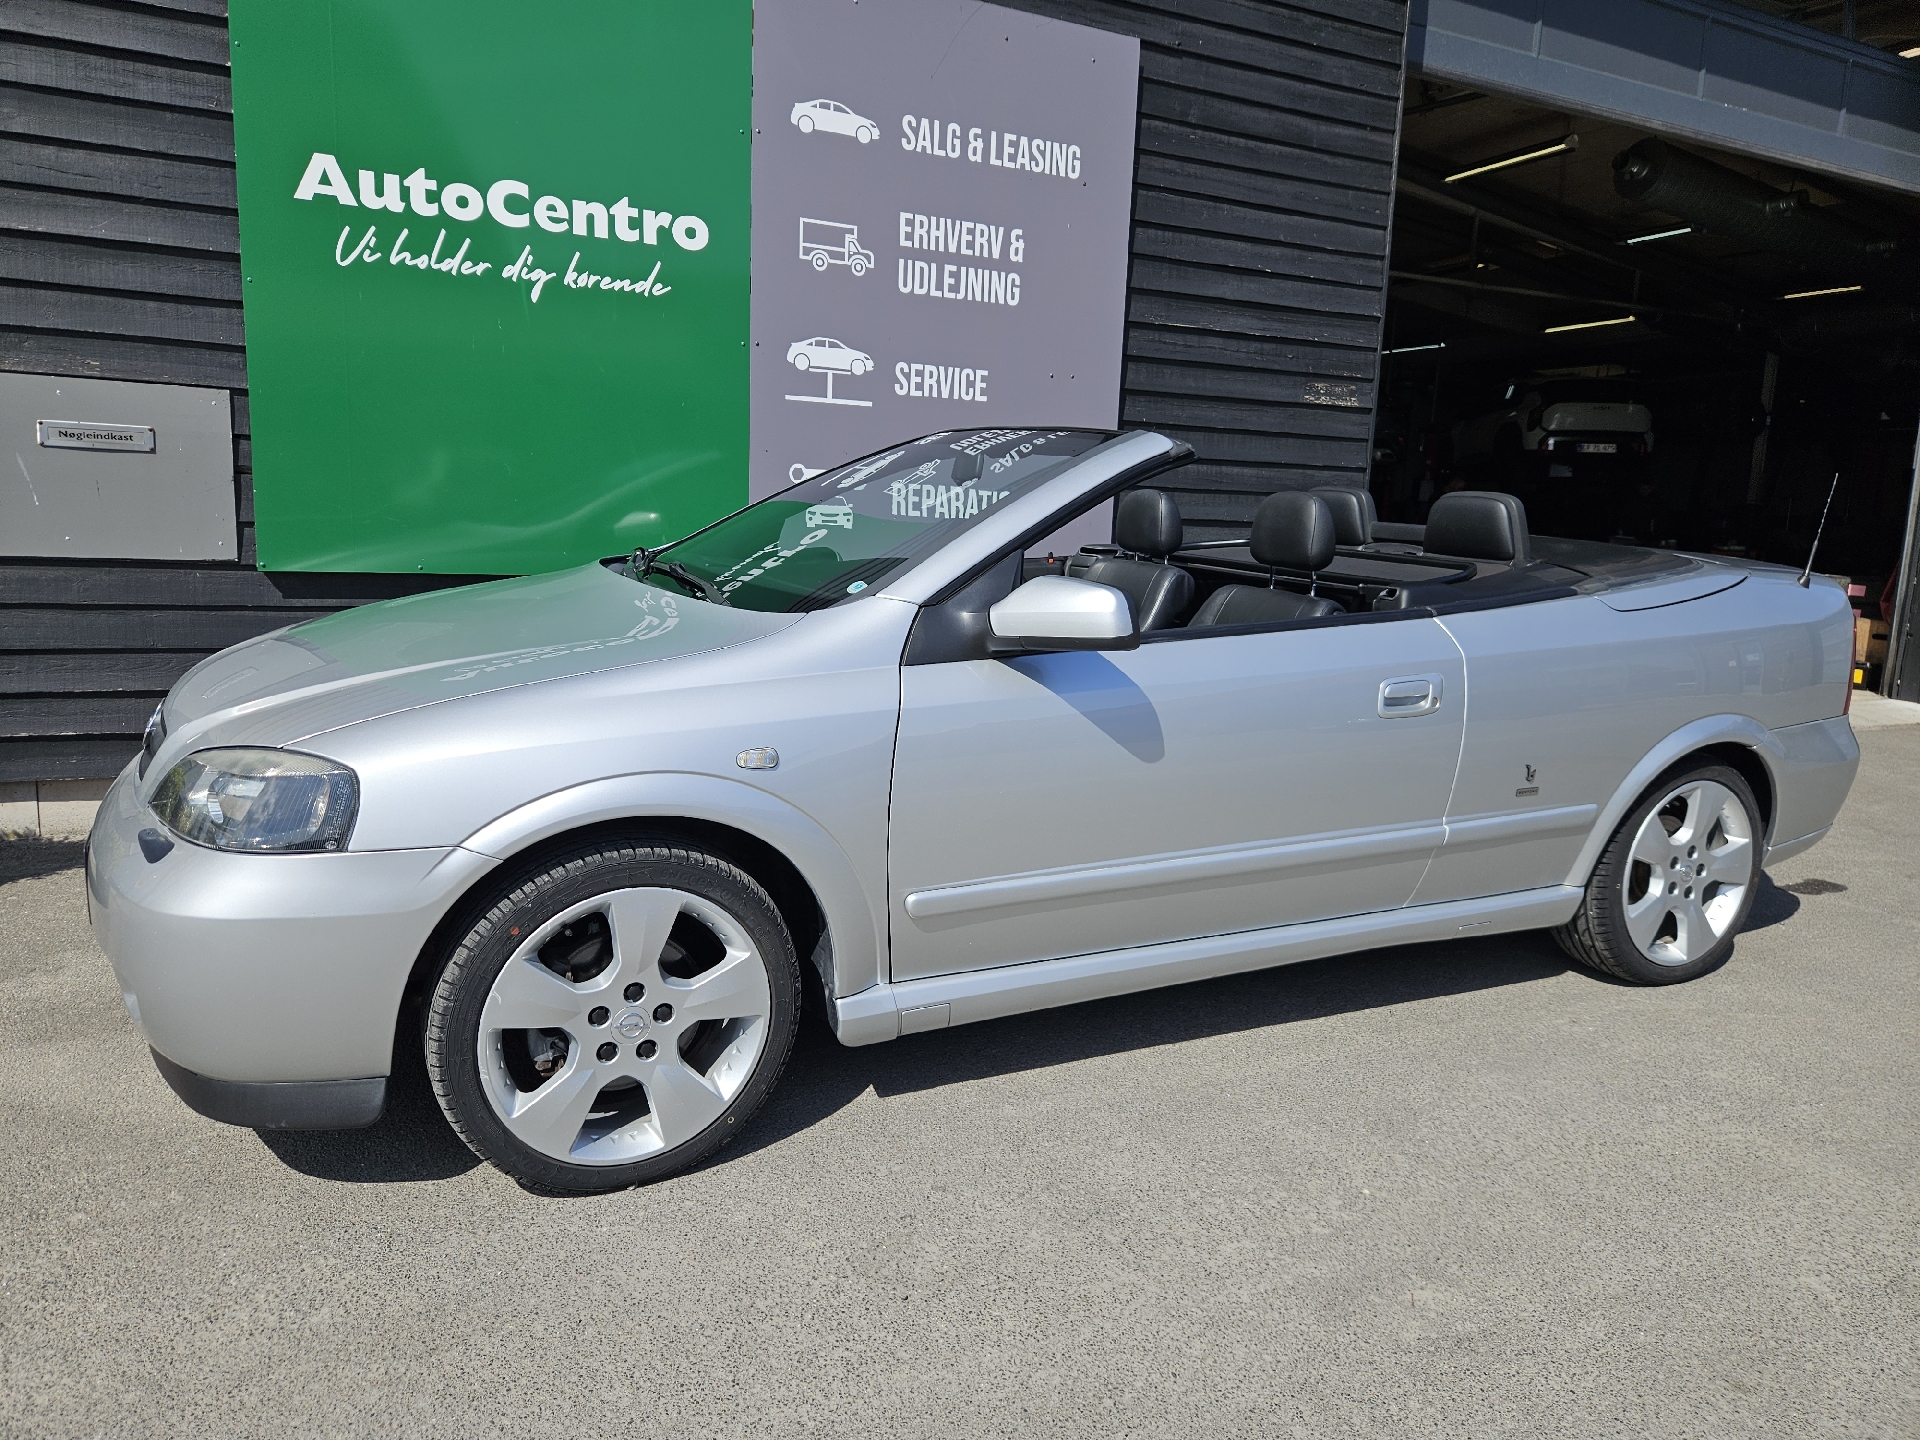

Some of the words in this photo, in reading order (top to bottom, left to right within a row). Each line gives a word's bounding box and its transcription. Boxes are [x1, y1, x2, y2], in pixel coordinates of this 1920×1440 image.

[901, 114, 961, 159] SALG
[967, 127, 983, 163] &
[989, 130, 1081, 179] LEASING
[294, 152, 709, 251] AutoCentro
[899, 211, 1004, 260] ERHVERV
[1009, 228, 1025, 263] &
[335, 225, 382, 267] Vi
[389, 228, 492, 276] holder
[501, 244, 557, 303] dig
[898, 258, 1021, 307] UDLEJNING
[894, 361, 989, 402] SERVICE
[58, 430, 134, 442] Nøgleindkast
